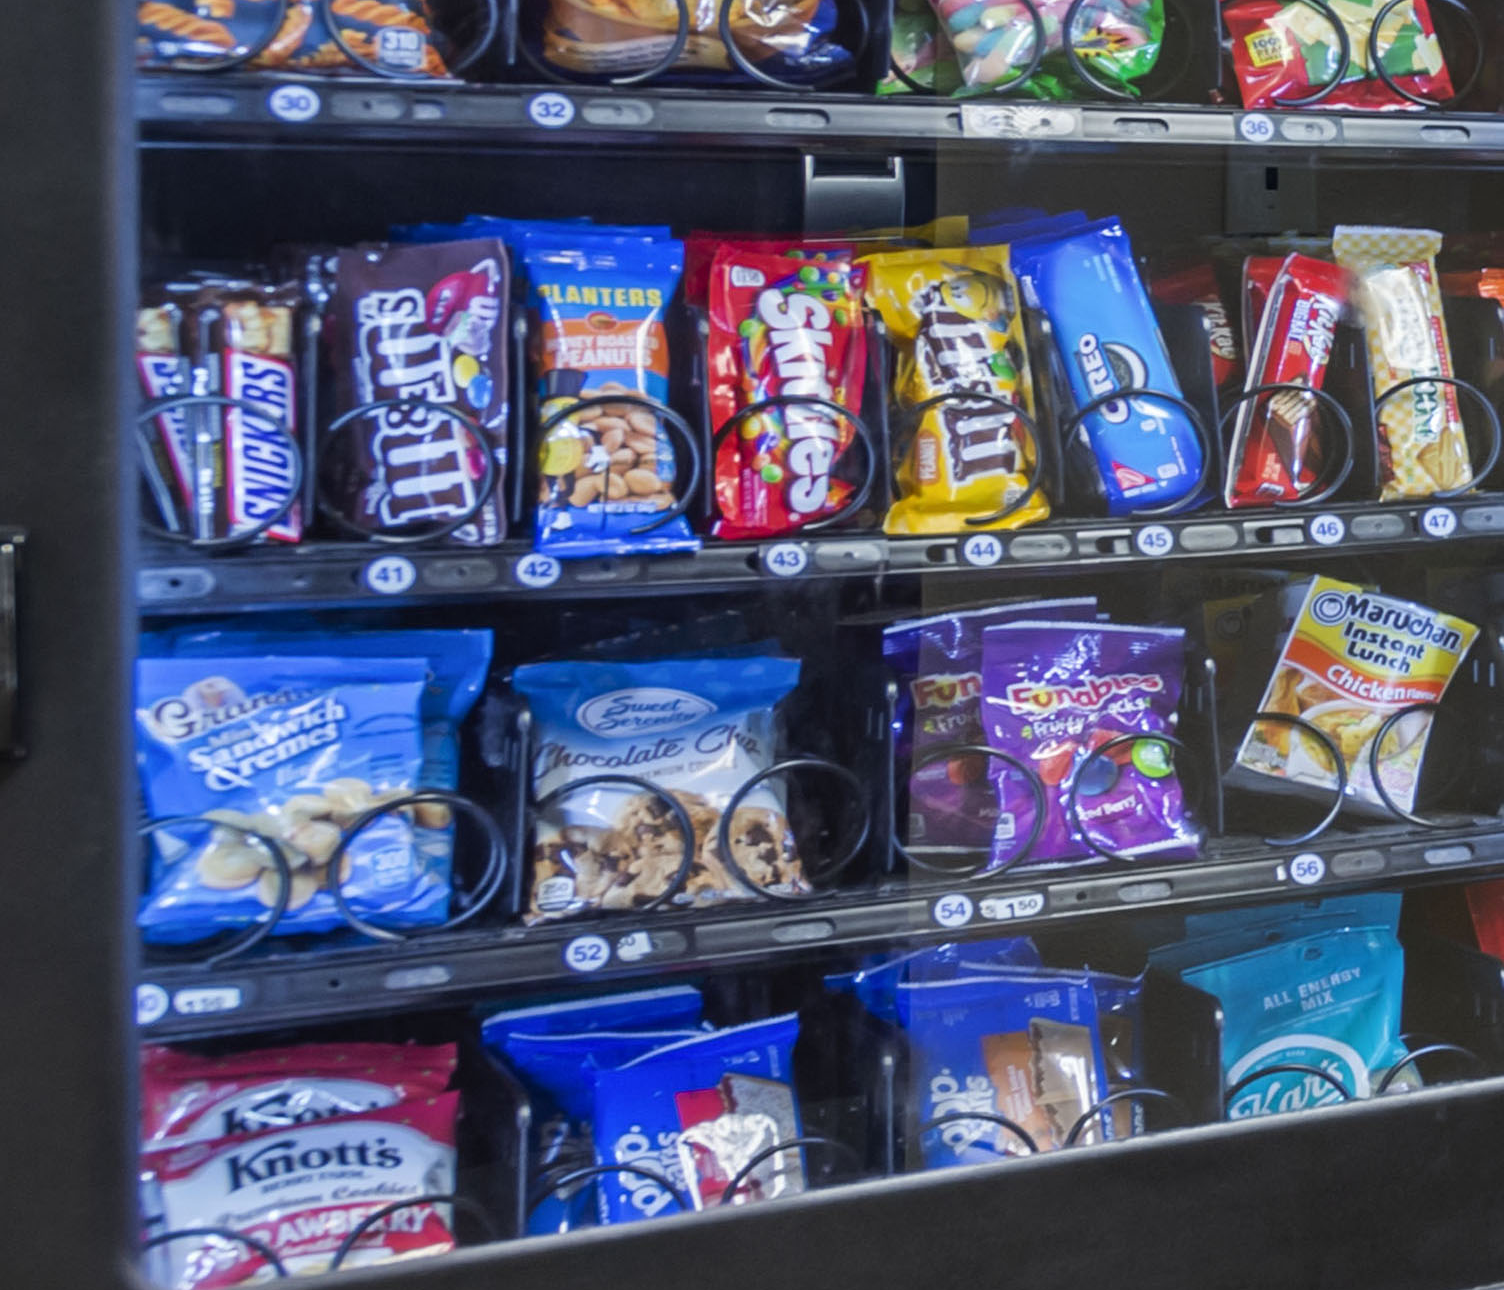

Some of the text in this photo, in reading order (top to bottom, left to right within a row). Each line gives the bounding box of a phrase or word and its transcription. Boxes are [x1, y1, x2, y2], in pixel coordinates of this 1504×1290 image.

[279, 94, 311, 112] 30
[539, 101, 566, 118] 32
[1245, 122, 1269, 135] 36
[1077, 333, 1132, 424] OREO
[1315, 523, 1338, 536] 46
[1428, 514, 1450, 529] 47
[1143, 533, 1166, 547] 45
[971, 542, 996, 557] 44
[773, 551, 799, 567] 43
[376, 564, 406, 584] 41
[523, 561, 552, 577] 42
[1343, 592, 1461, 653] Maruchan
[1342, 620, 1426, 661] Instant
[1346, 640, 1412, 675] Lunch
[1325, 662, 1406, 702] Chicken
[1007, 674, 1163, 714] Funables
[608, 695, 691, 714] Sweet
[534, 738, 685, 781] Chocolate
[1294, 860, 1318, 877] 56
[940, 902, 967, 919] 54
[573, 944, 602, 962] 52
[1262, 966, 1362, 1011] ALL ENERGY
[1300, 990, 1335, 1012] MIX
[225, 1137, 404, 1196] Knott's
